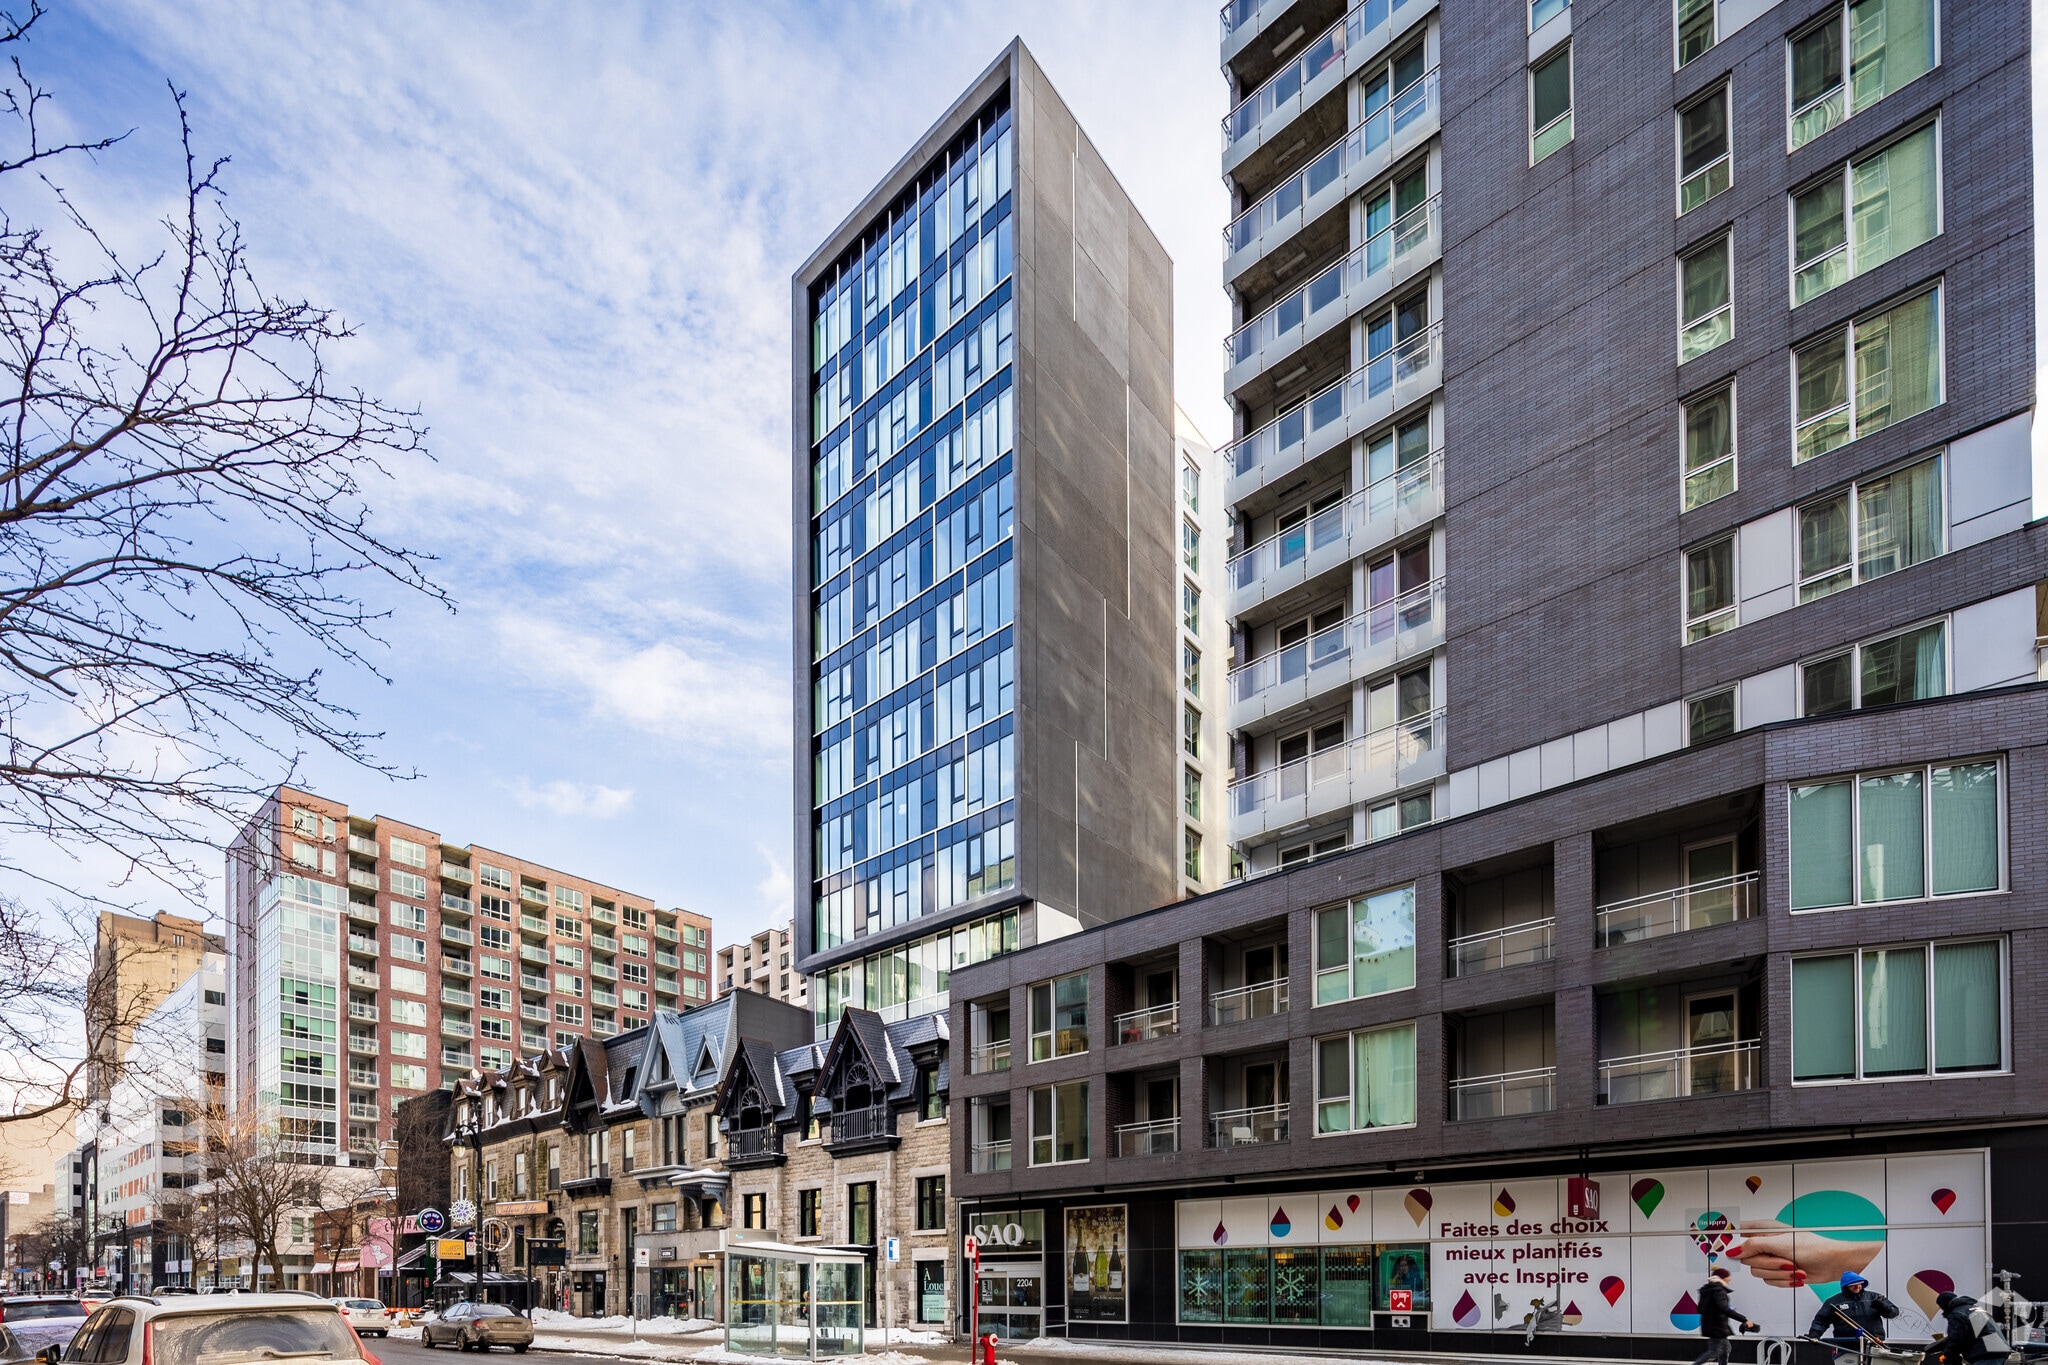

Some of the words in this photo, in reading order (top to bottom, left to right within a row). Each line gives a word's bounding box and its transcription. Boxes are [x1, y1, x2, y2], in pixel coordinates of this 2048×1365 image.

[1585, 1187, 1598, 1211] SAQ
[974, 1223, 1025, 1247] SAQ
[1441, 1222, 1500, 1238] Faites
[1506, 1219, 1543, 1236] des
[1550, 1217, 1609, 1234] choix
[1446, 1246, 1505, 1261] mieux
[1513, 1242, 1603, 1264] planifiés
[1016, 1279, 1033, 1287] 2204
[1464, 1272, 1510, 1284] avec
[1516, 1267, 1589, 1288] Inspire
